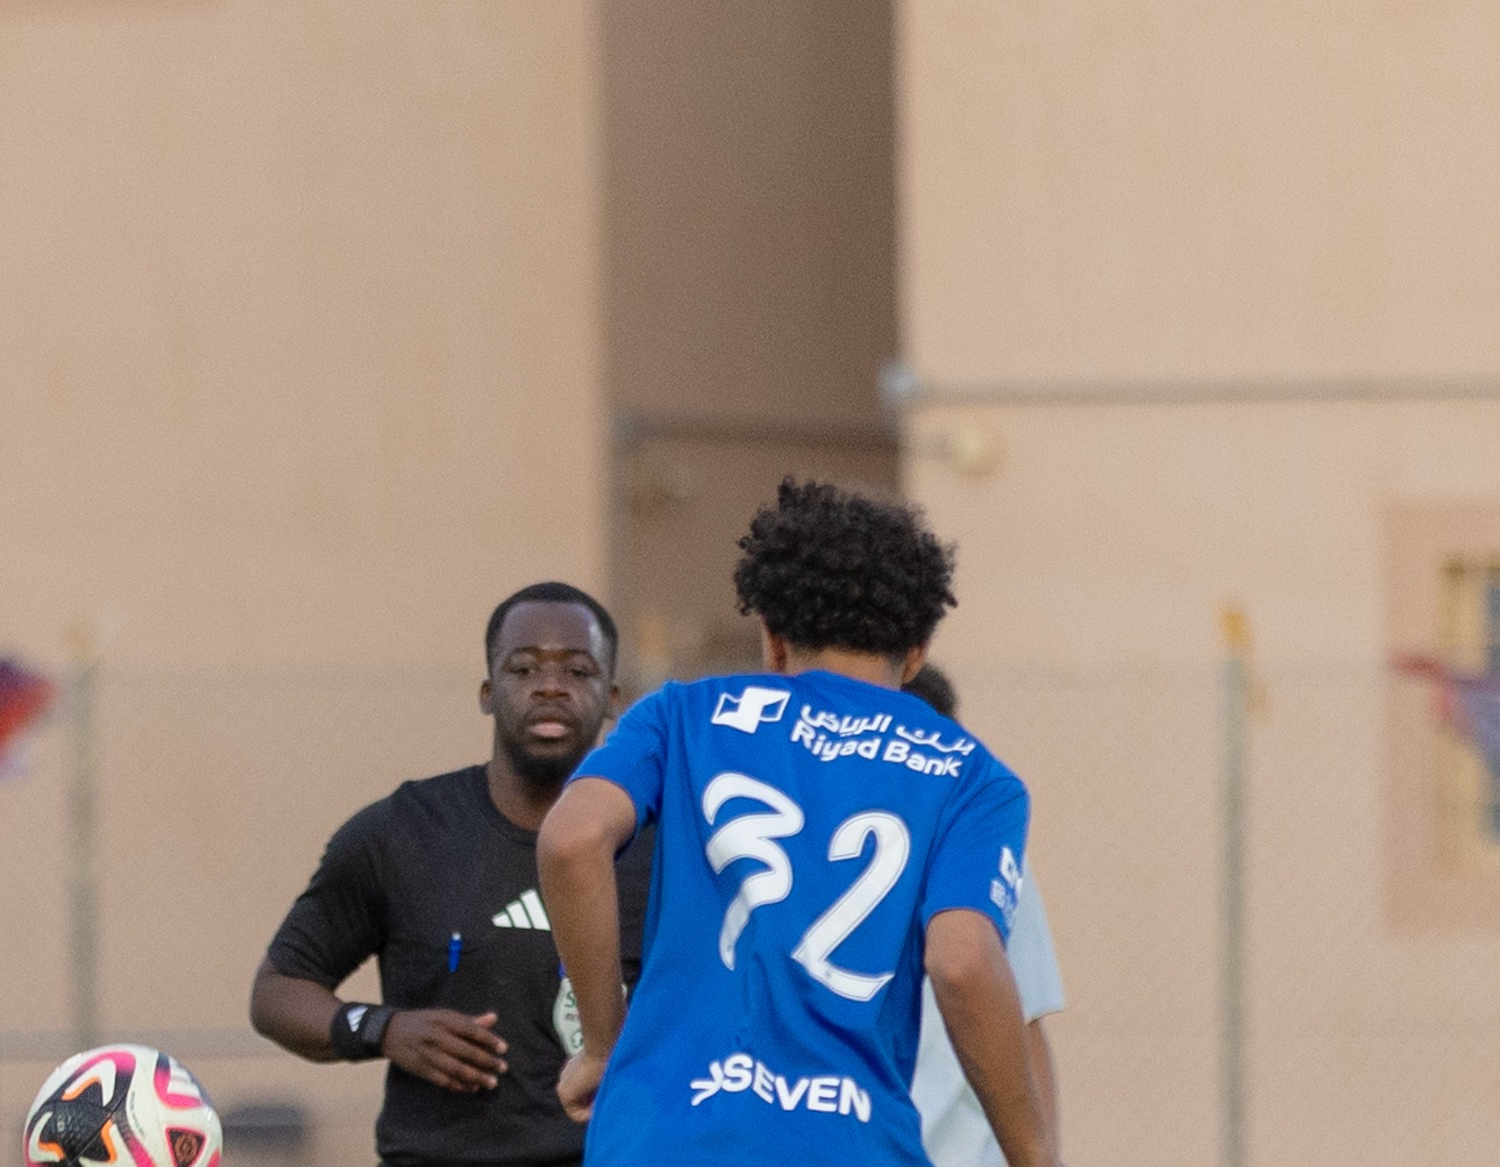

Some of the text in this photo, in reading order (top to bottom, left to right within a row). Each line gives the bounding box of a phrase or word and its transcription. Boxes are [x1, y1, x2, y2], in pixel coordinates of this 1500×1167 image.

[791, 719, 963, 777] Riyad Bank
[801, 704, 892, 738] الرياض
[702, 772, 911, 1003] 32
[721, 1051, 872, 1123] SEVEN
